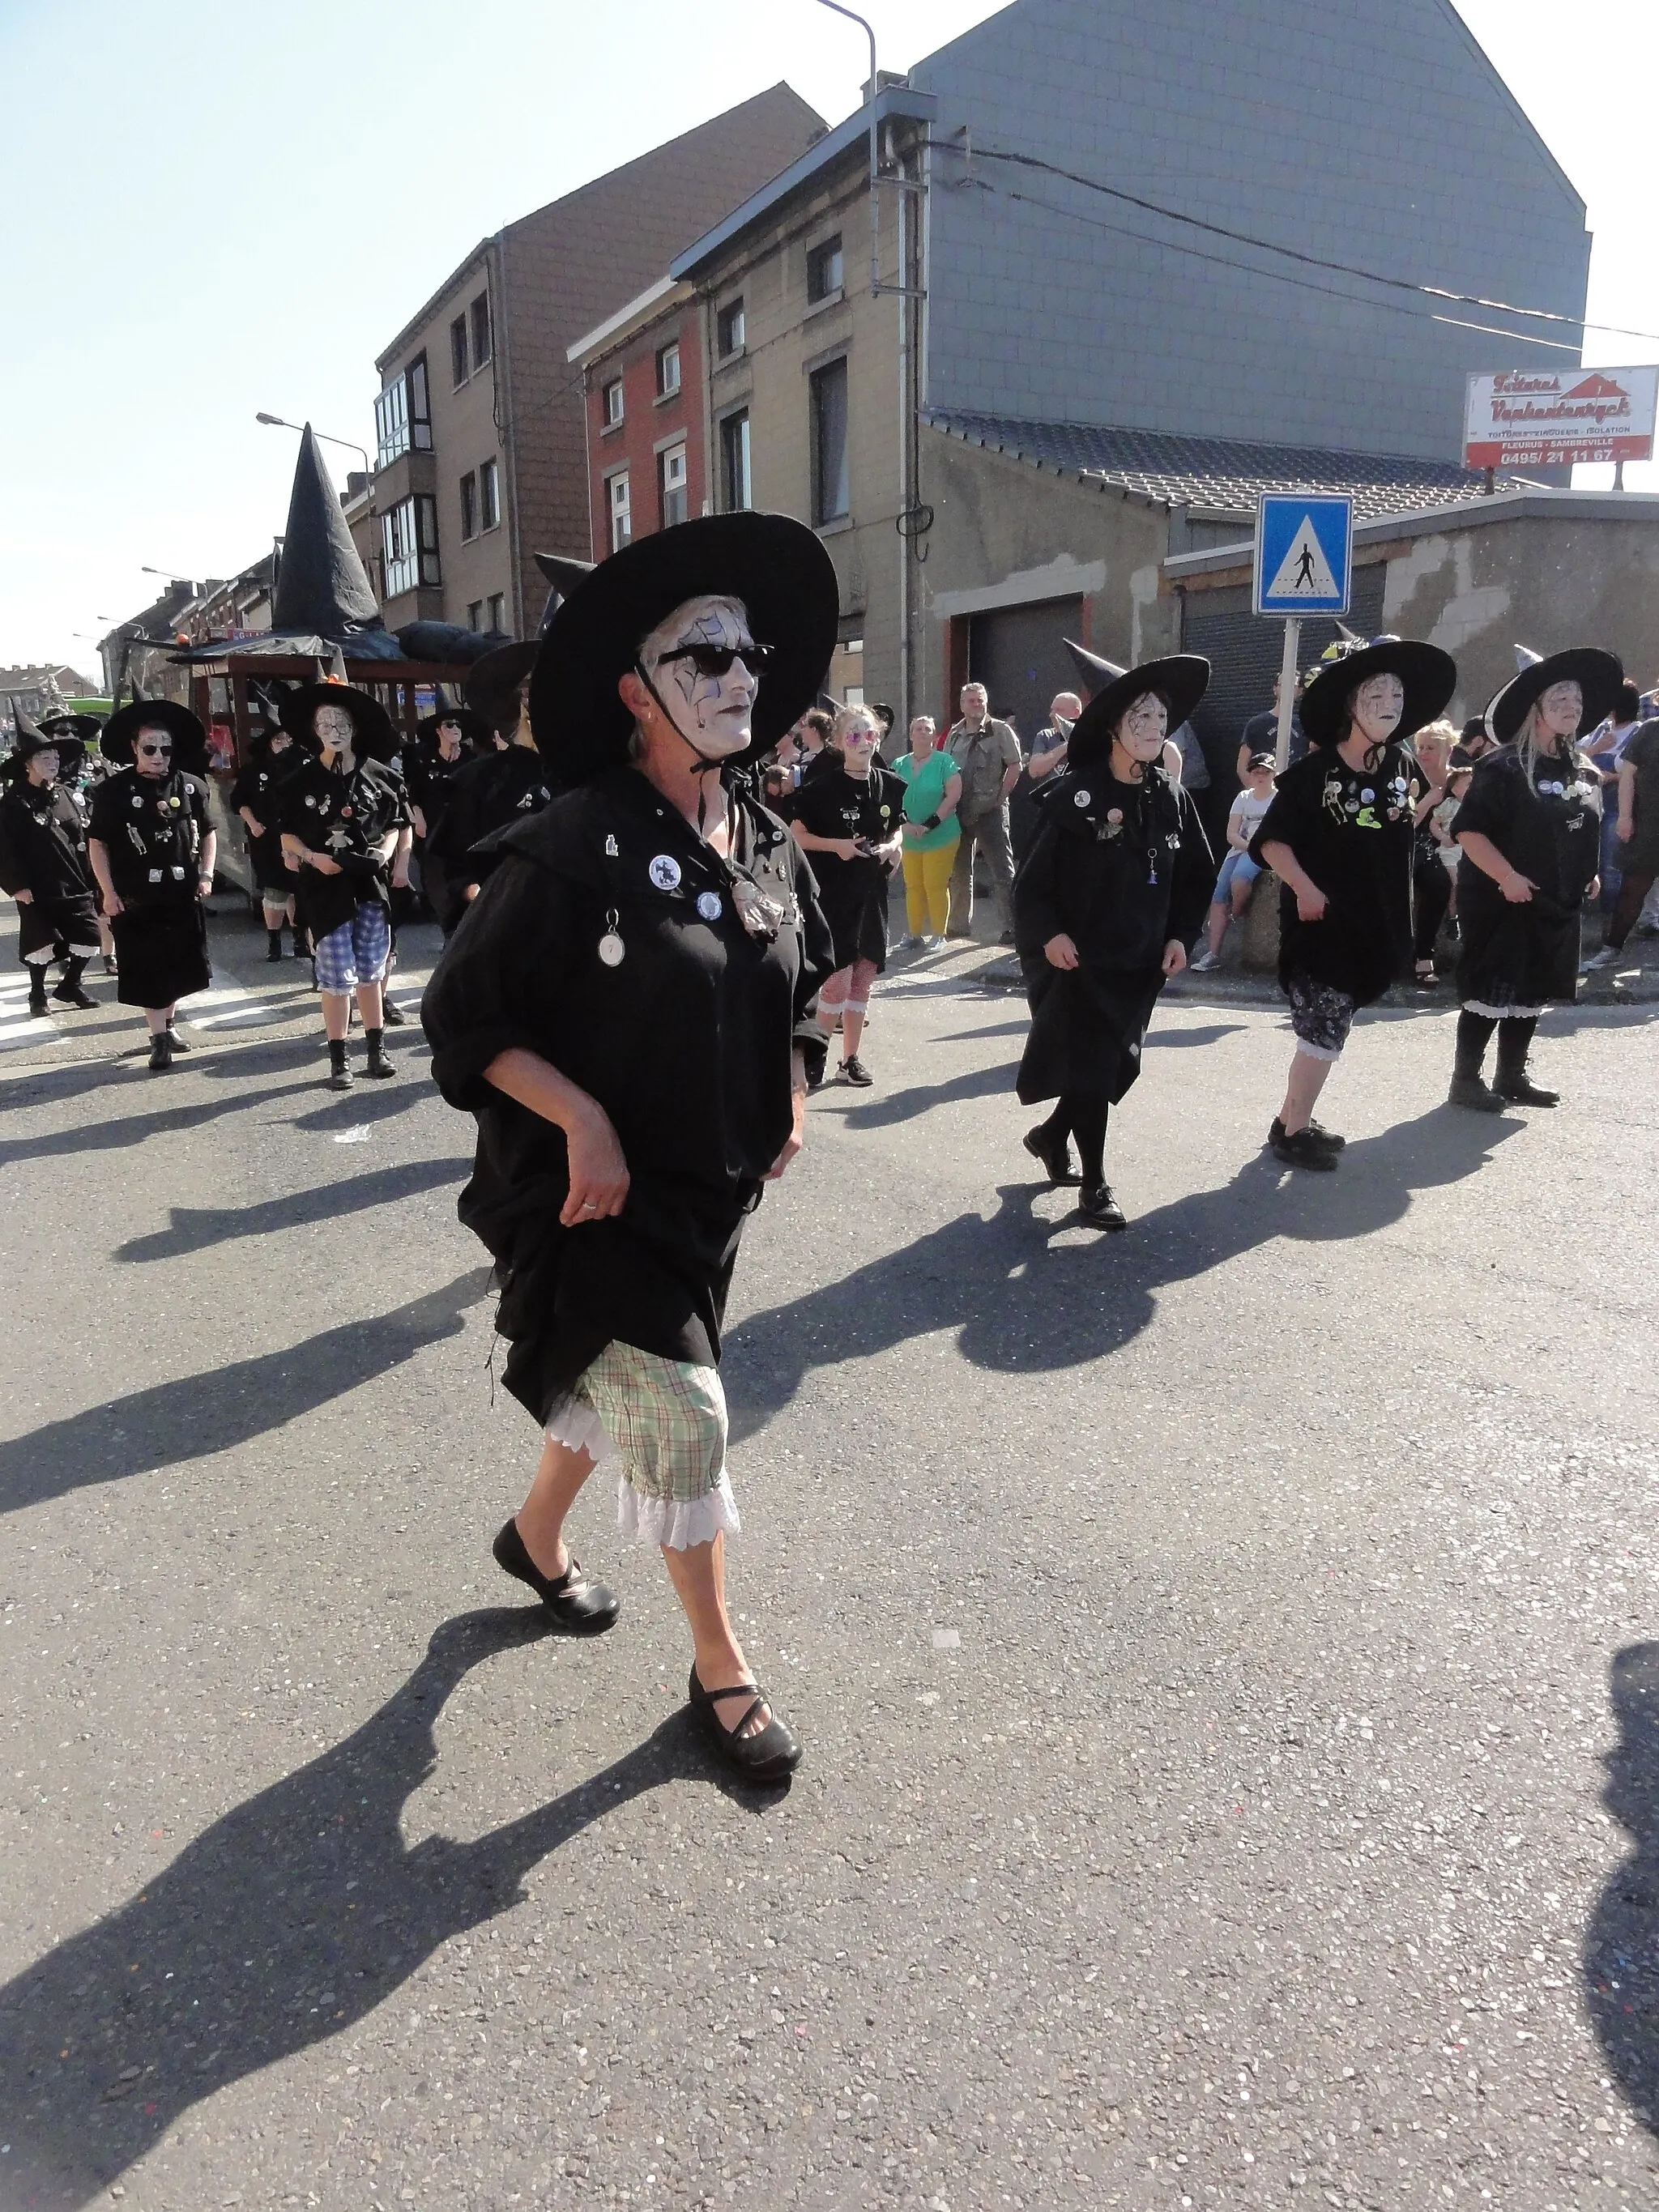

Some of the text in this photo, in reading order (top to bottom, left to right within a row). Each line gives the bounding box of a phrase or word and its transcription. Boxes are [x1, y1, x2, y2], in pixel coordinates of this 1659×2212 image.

[1586, 426, 1631, 434] ISOLATION
[1502, 438, 1614, 450] FLEURUS SAMBREVILLE
[1593, 449, 1613, 461] 67
